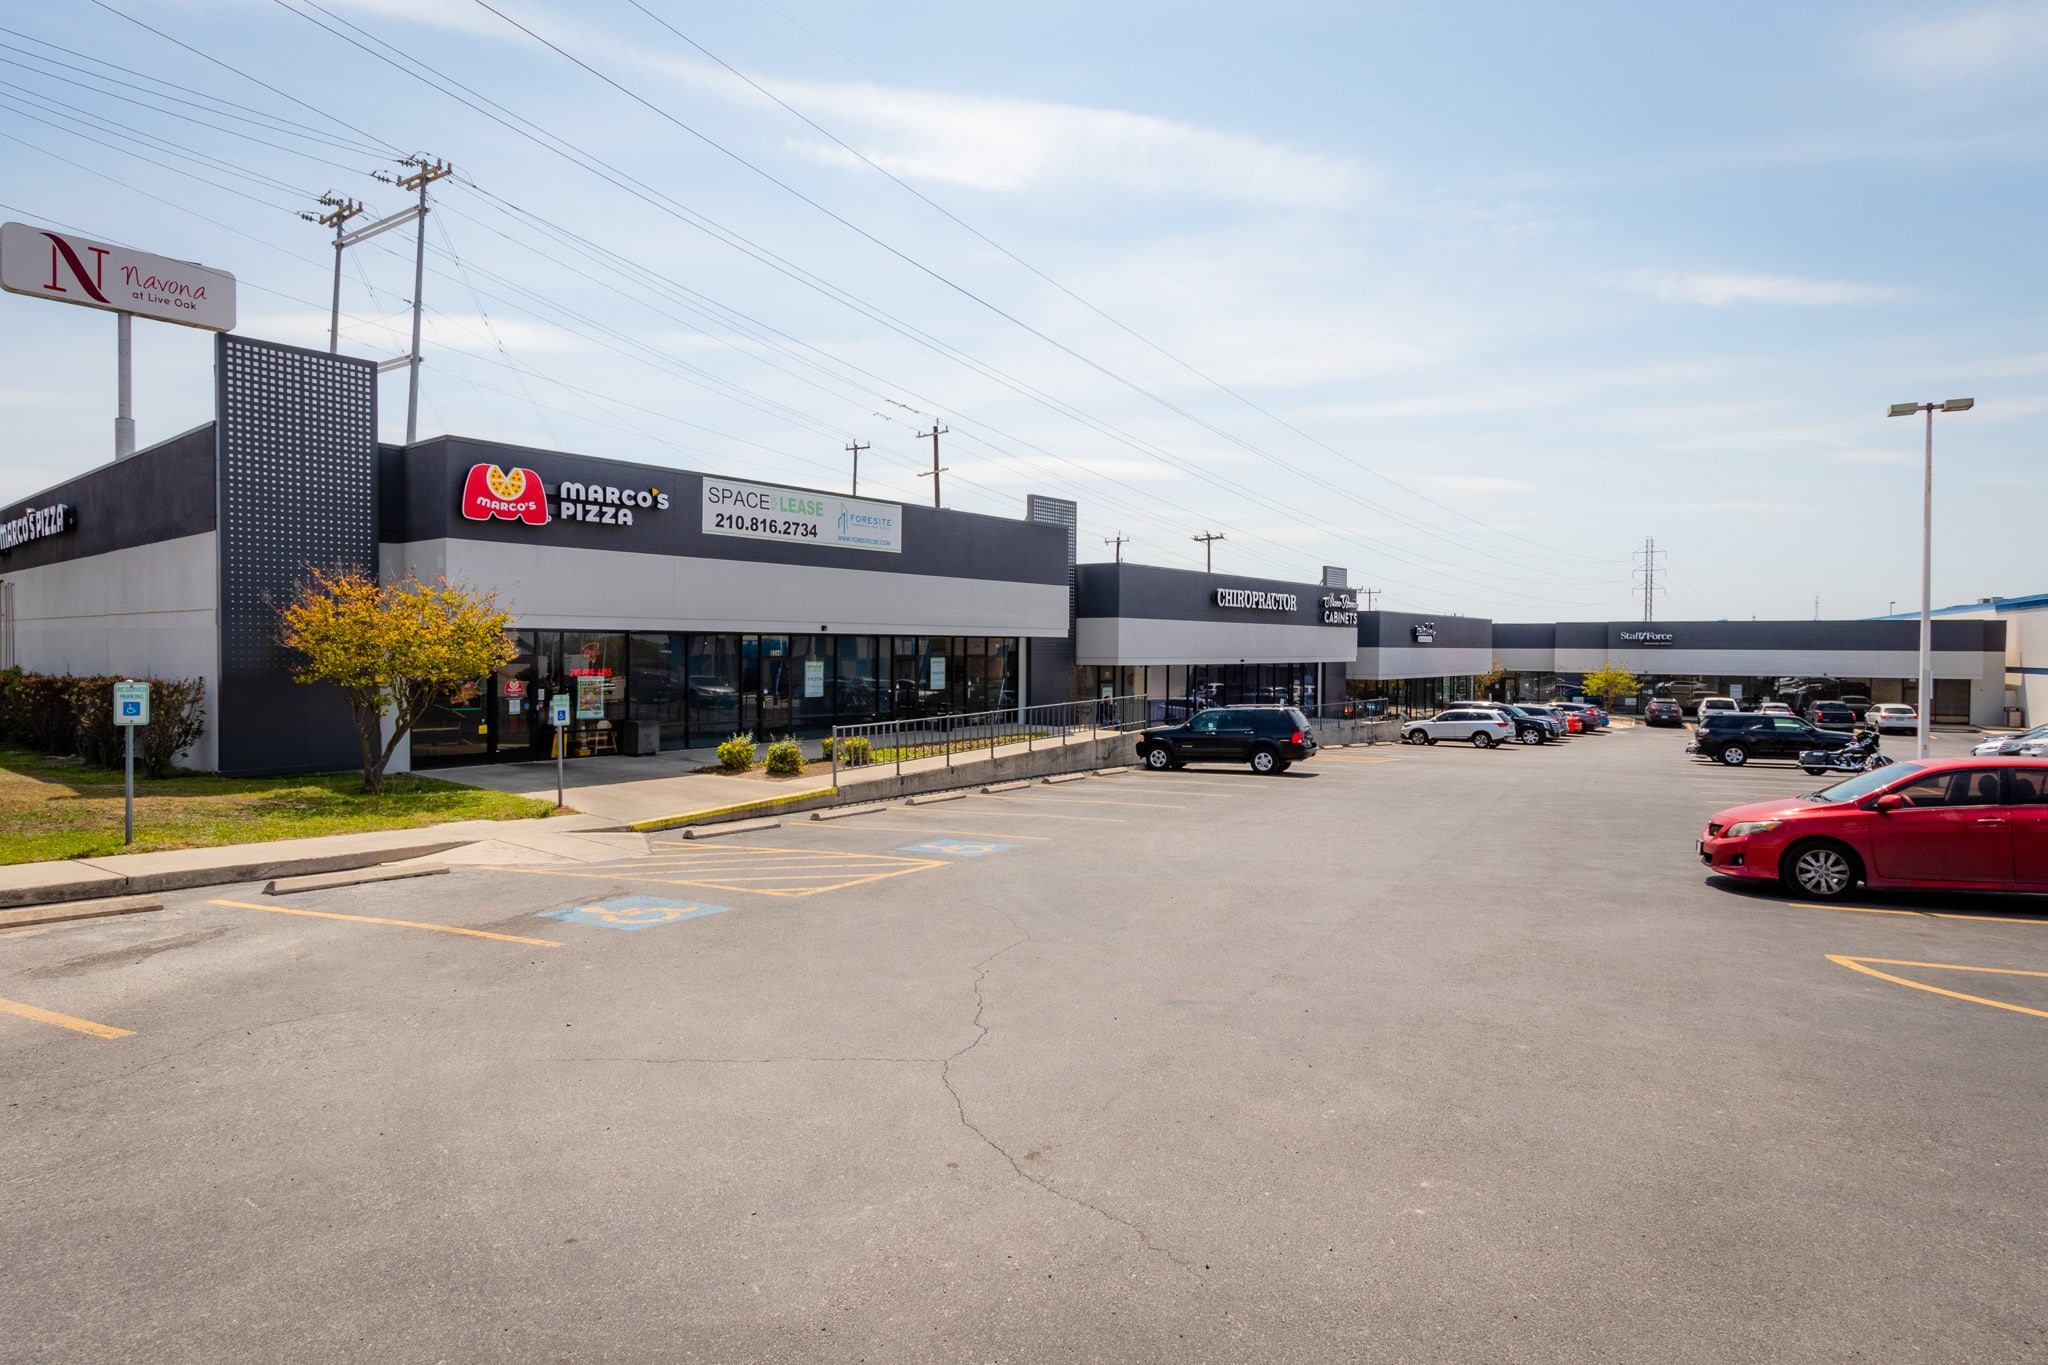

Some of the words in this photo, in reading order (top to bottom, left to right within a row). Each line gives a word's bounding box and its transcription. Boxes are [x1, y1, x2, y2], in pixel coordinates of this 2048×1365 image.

[39, 232, 112, 304] N
[121, 265, 207, 300] Navona
[132, 290, 144, 300] at
[148, 291, 170, 305] Live
[174, 298, 197, 310] Oak
[476, 496, 537, 512] MARCO'S
[560, 481, 670, 510] MARCO'S
[708, 486, 770, 510] SPACE
[779, 496, 824, 517] LEASE
[36, 504, 64, 538] PIZZA
[560, 501, 633, 526] PIZZA
[715, 513, 818, 538] 210.816.2734
[850, 514, 892, 527] FORESITE
[1217, 588, 1298, 612] CHIROPRACTOR
[1324, 610, 1358, 625] CABINETS
